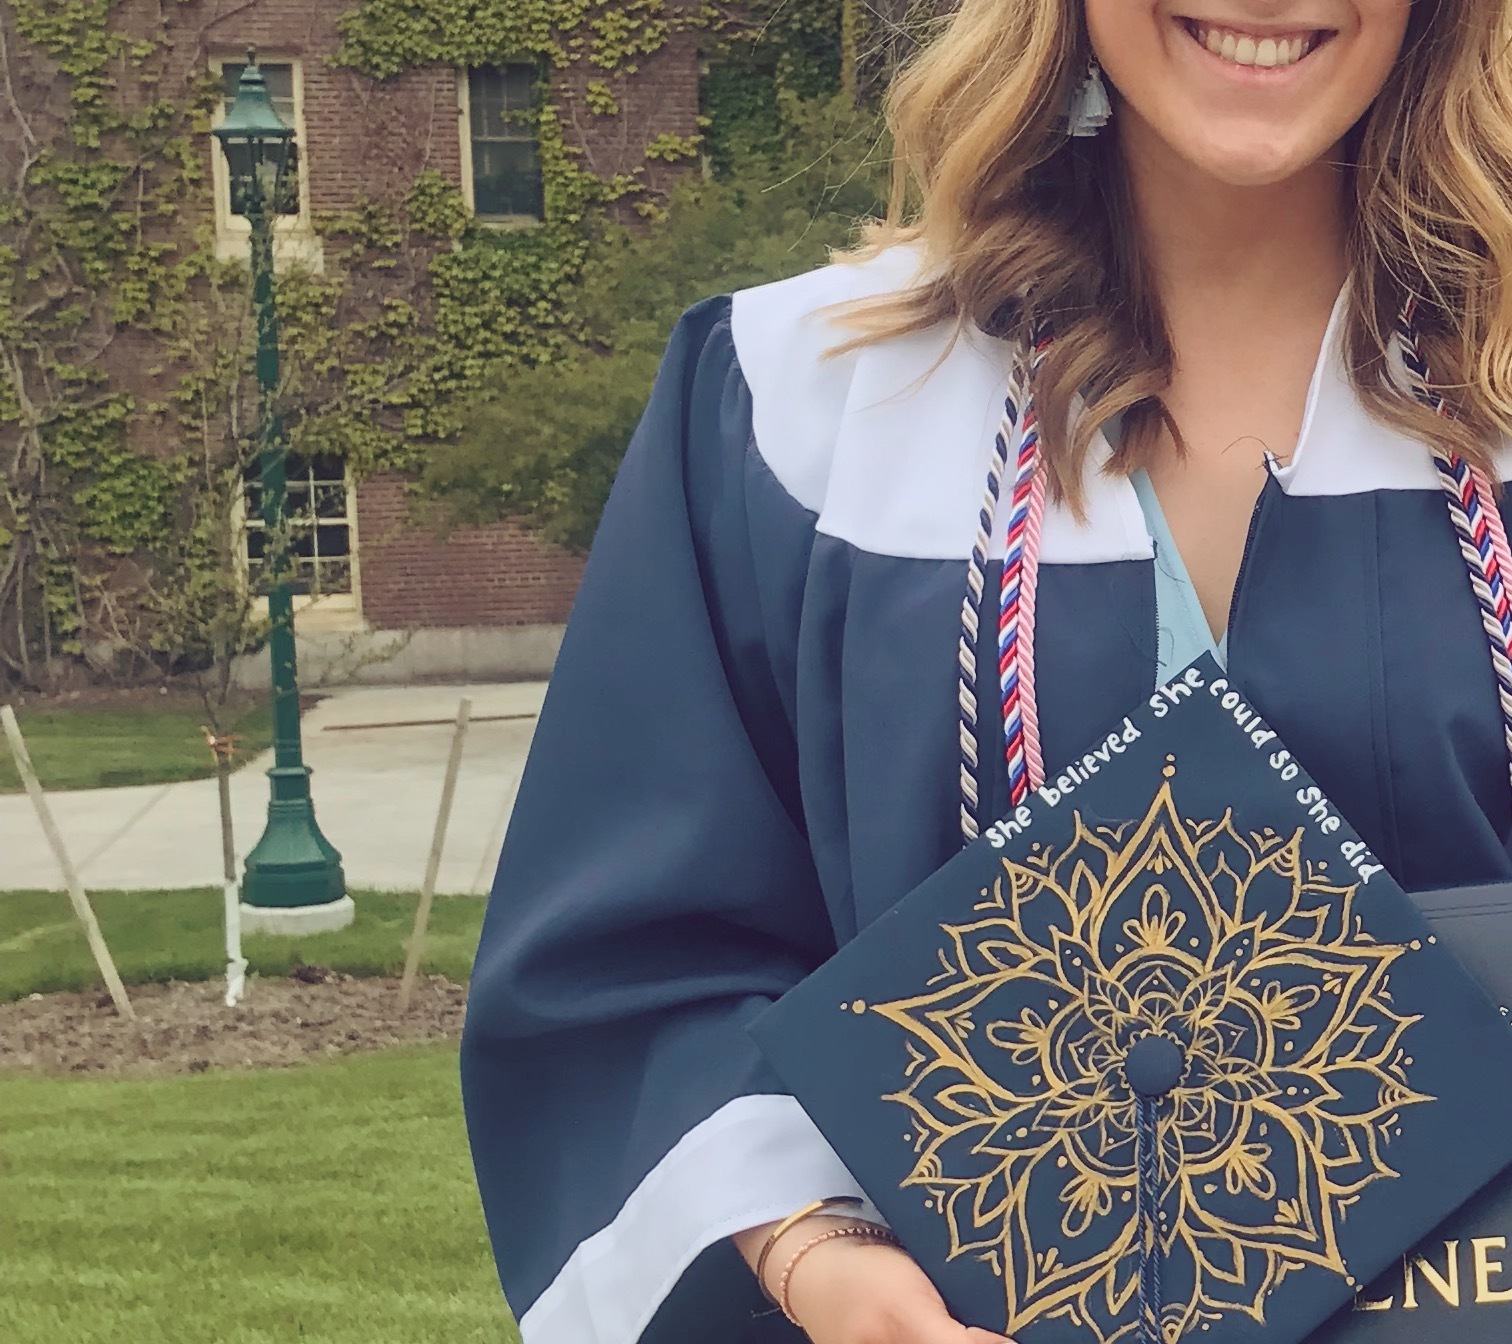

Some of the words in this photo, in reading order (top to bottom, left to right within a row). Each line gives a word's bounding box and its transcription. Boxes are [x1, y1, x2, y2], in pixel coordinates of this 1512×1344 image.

[1038, 716, 1143, 808] believed
[1209, 677, 1278, 749] could
[1269, 750, 1299, 782] so
[1340, 840, 1385, 885] did
